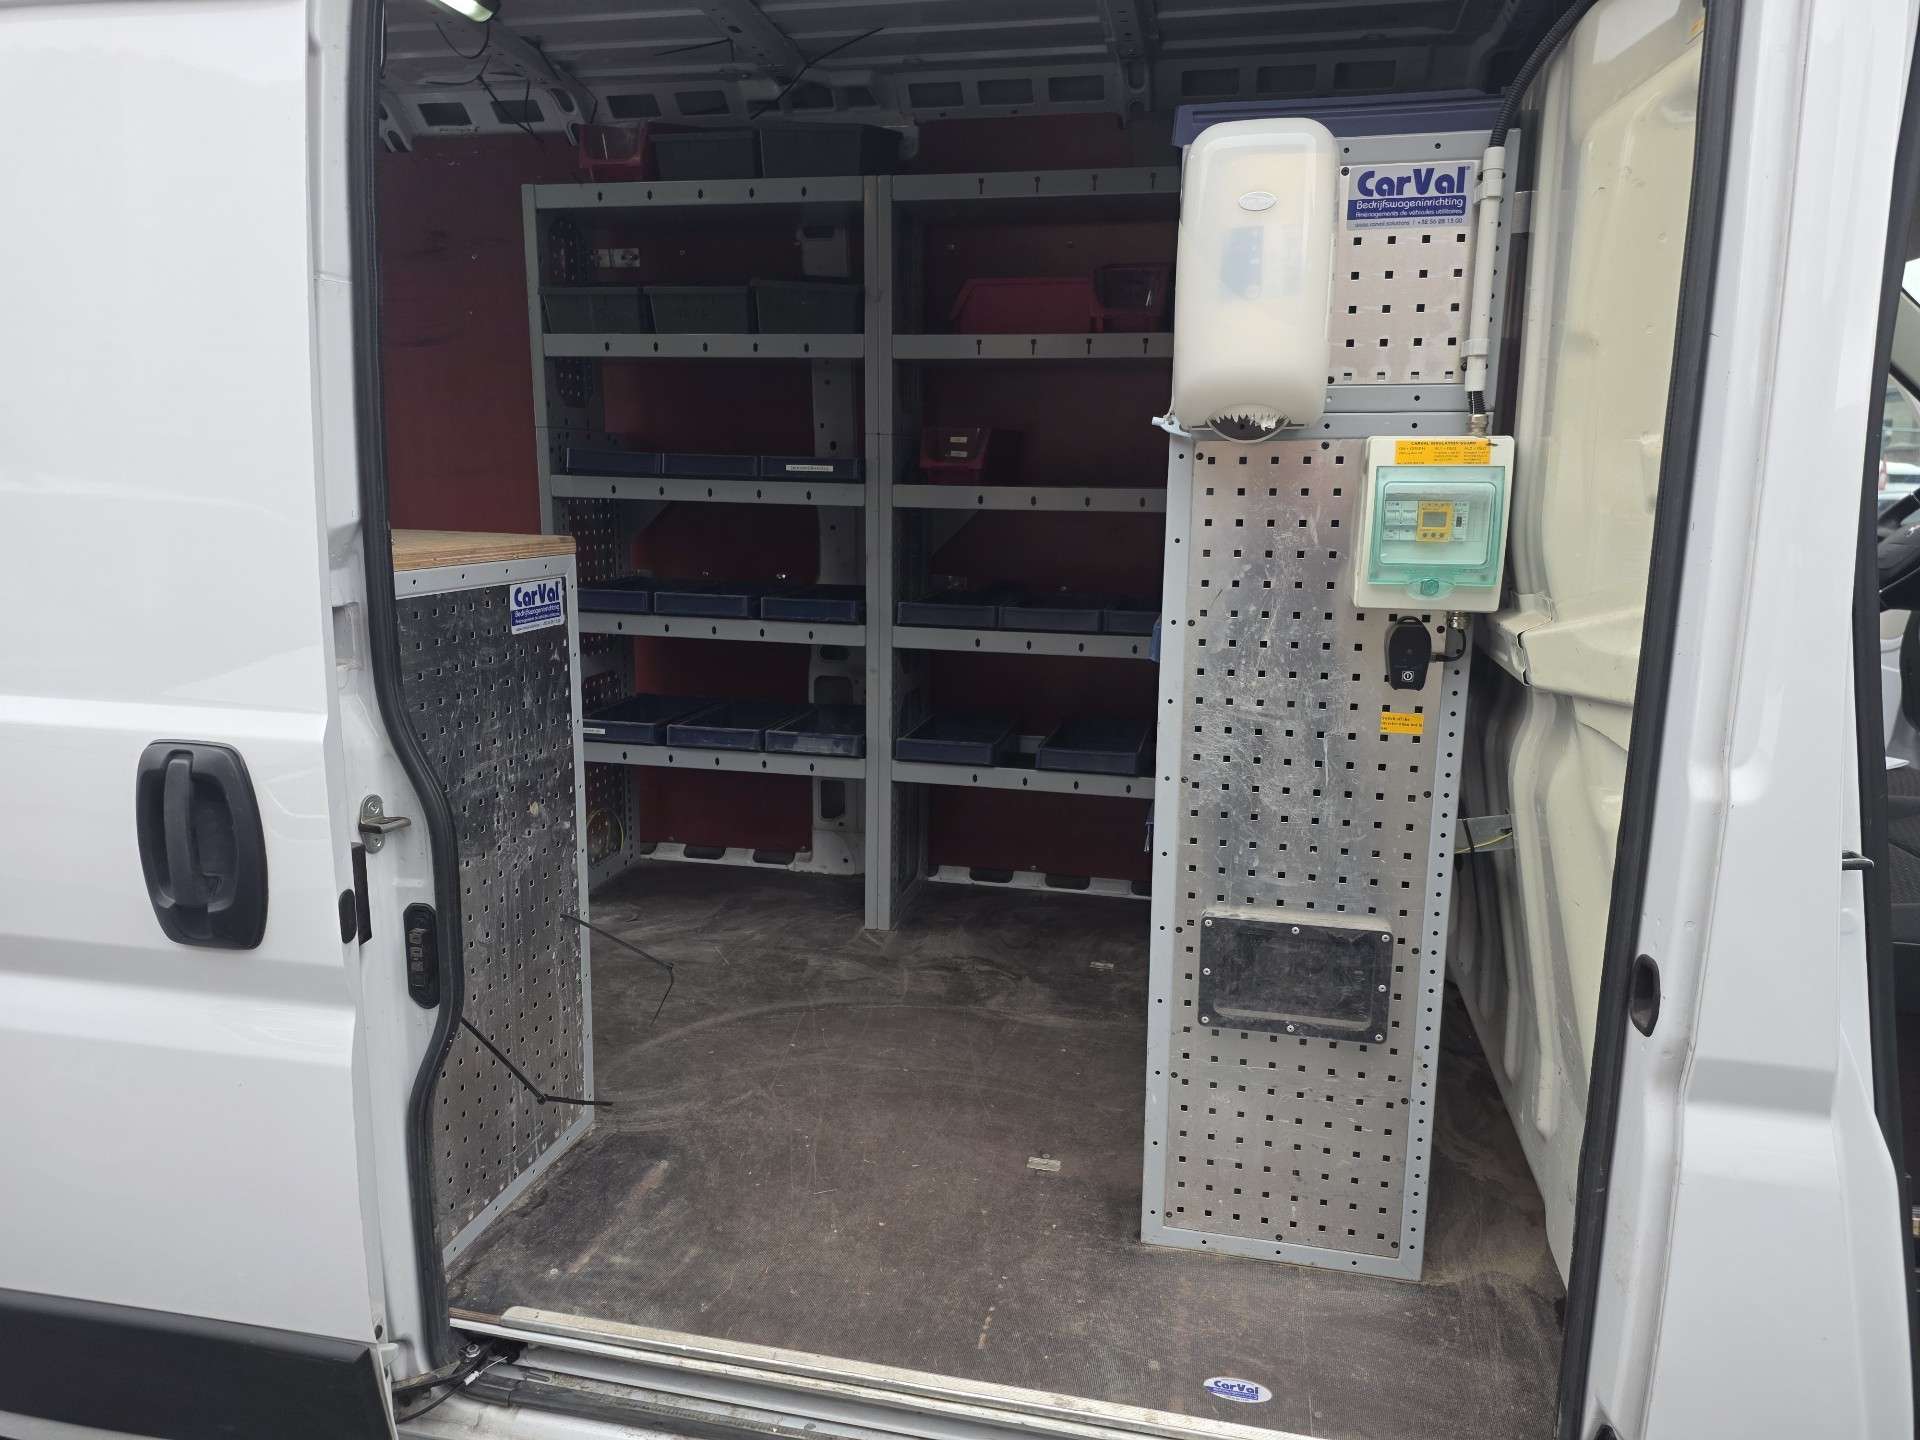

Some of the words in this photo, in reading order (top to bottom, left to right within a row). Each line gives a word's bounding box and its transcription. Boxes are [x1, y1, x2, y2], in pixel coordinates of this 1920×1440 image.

[1357, 166, 1466, 197] CarVal
[1356, 198, 1464, 211] Bedrijfswageninrichting
[514, 581, 560, 608] CarVal
[1214, 1380, 1259, 1394] CarVal
